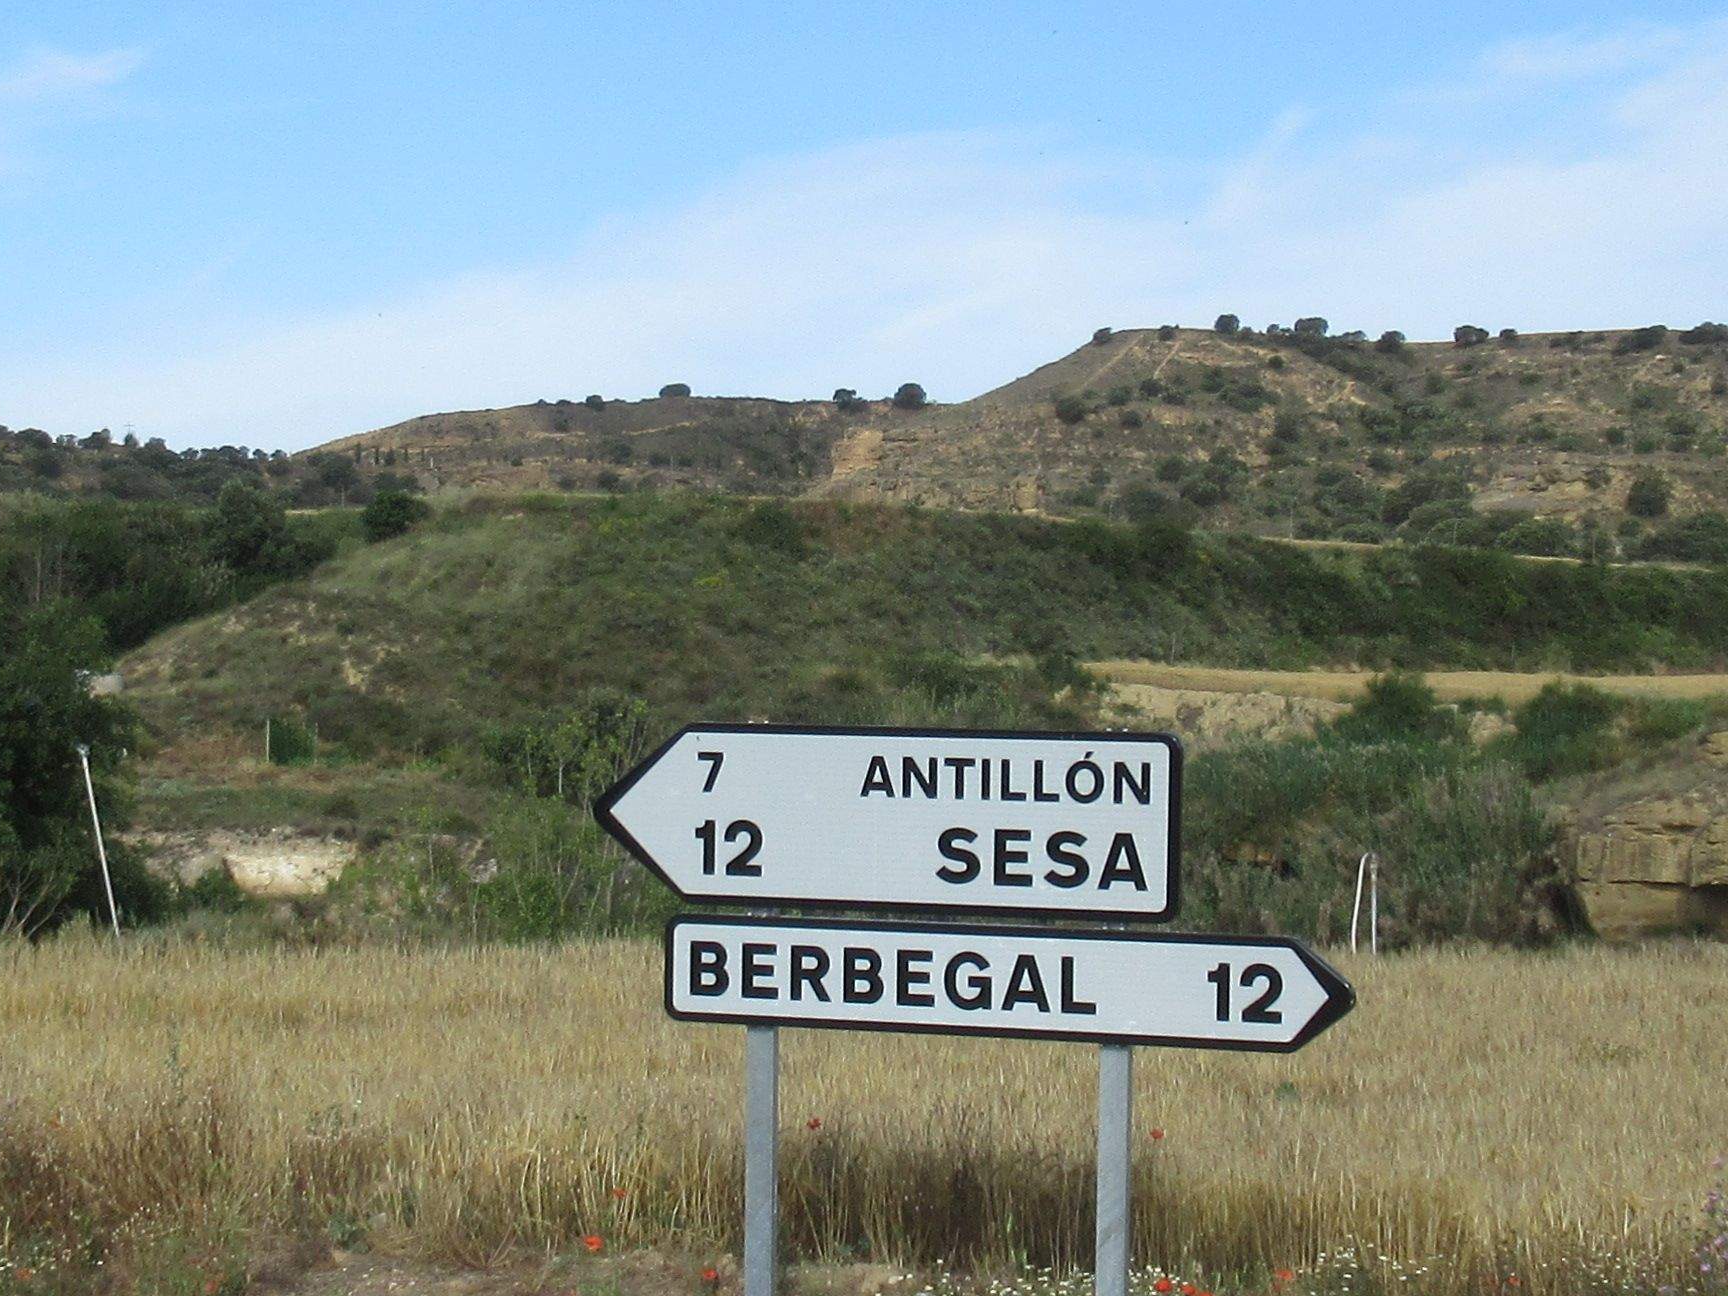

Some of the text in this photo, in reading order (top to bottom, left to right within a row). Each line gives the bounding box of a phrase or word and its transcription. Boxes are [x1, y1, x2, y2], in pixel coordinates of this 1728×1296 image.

[697, 751, 1151, 806] 7 ANTILLÓN
[694, 819, 1148, 892] 12 SESA
[688, 940, 1283, 1025] BERBEGAL 12
